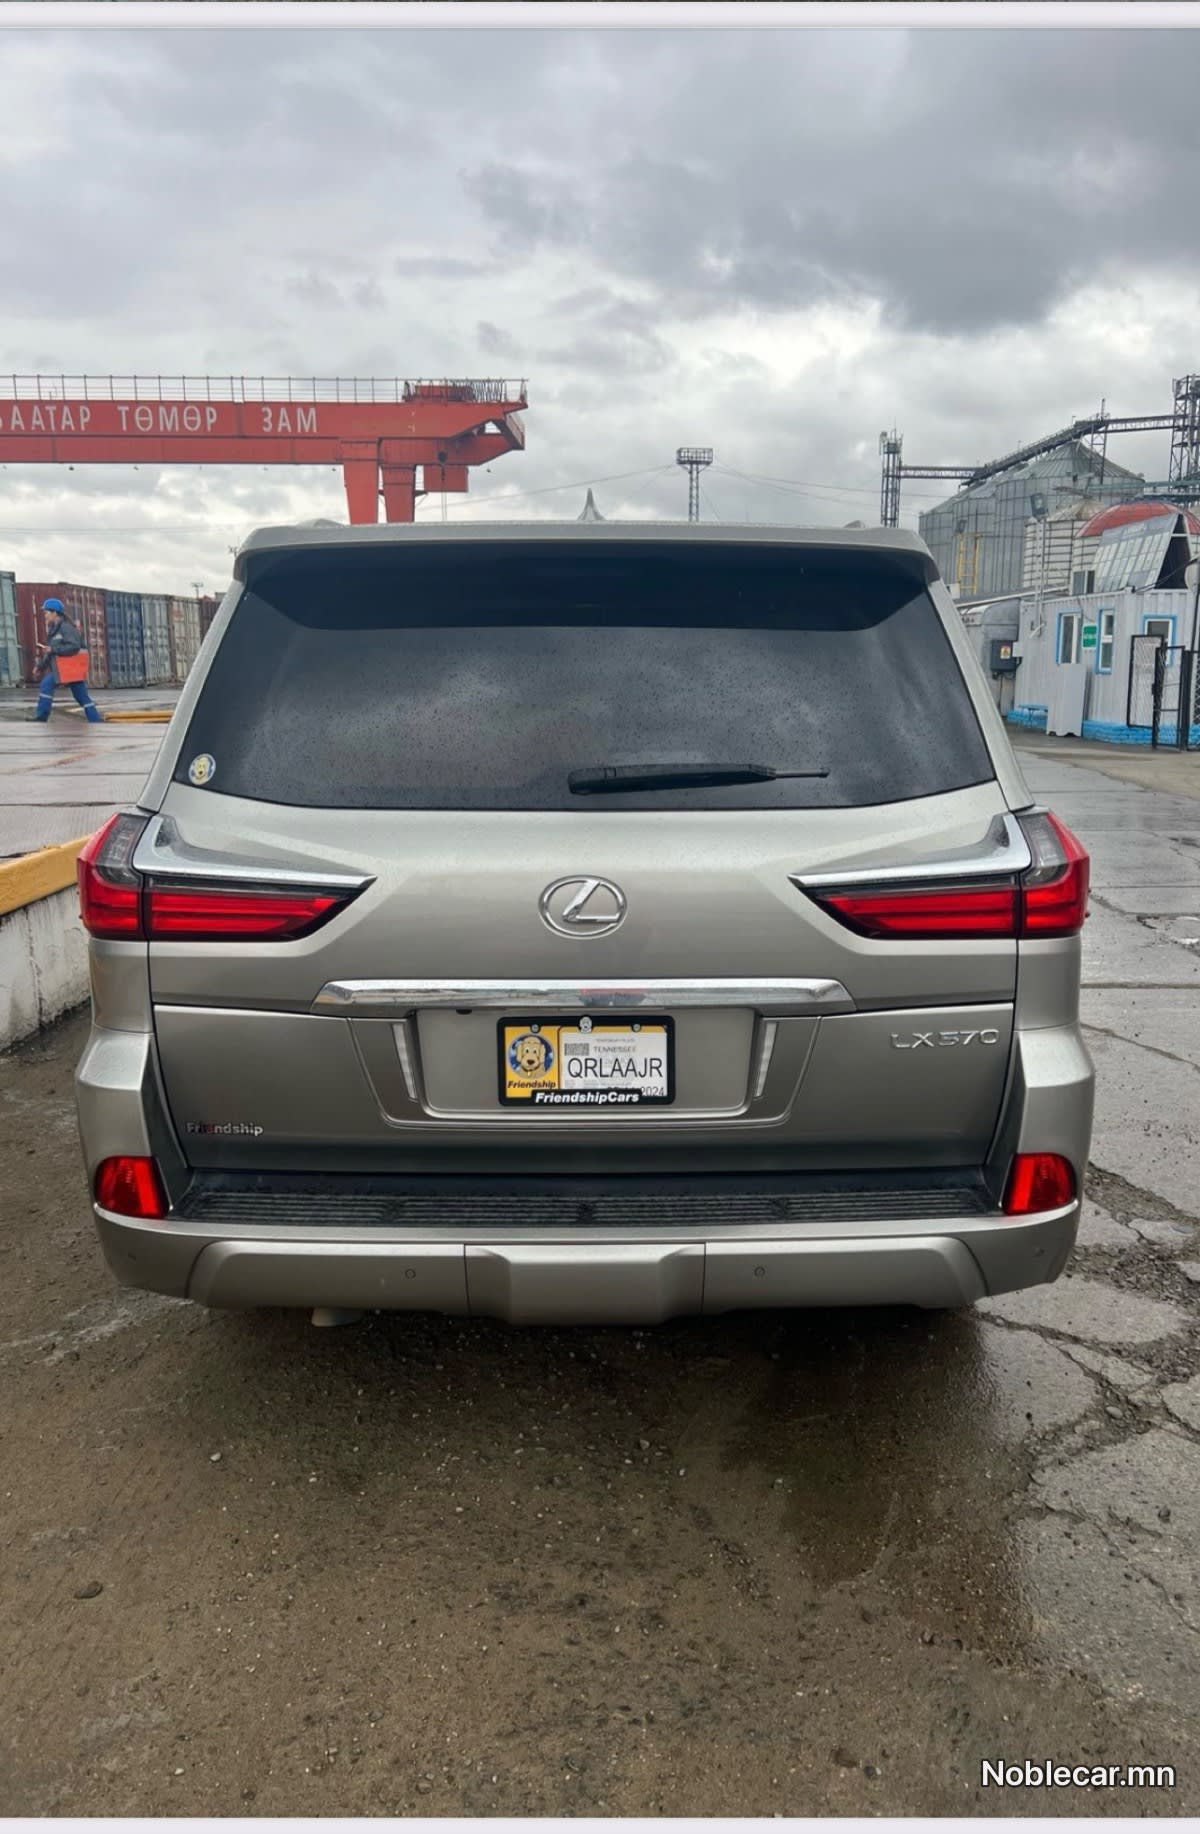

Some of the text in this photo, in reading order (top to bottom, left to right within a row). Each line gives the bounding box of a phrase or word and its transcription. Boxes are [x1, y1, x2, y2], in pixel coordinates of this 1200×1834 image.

[0, 405, 318, 433] ААТАР ТӨМӨР ЗАМ
[891, 1029, 1000, 1049] LX 570
[567, 1057, 663, 1079] QRLAAJR
[507, 1080, 556, 1090] Friendship
[535, 1092, 639, 1104] FriendshipCars
